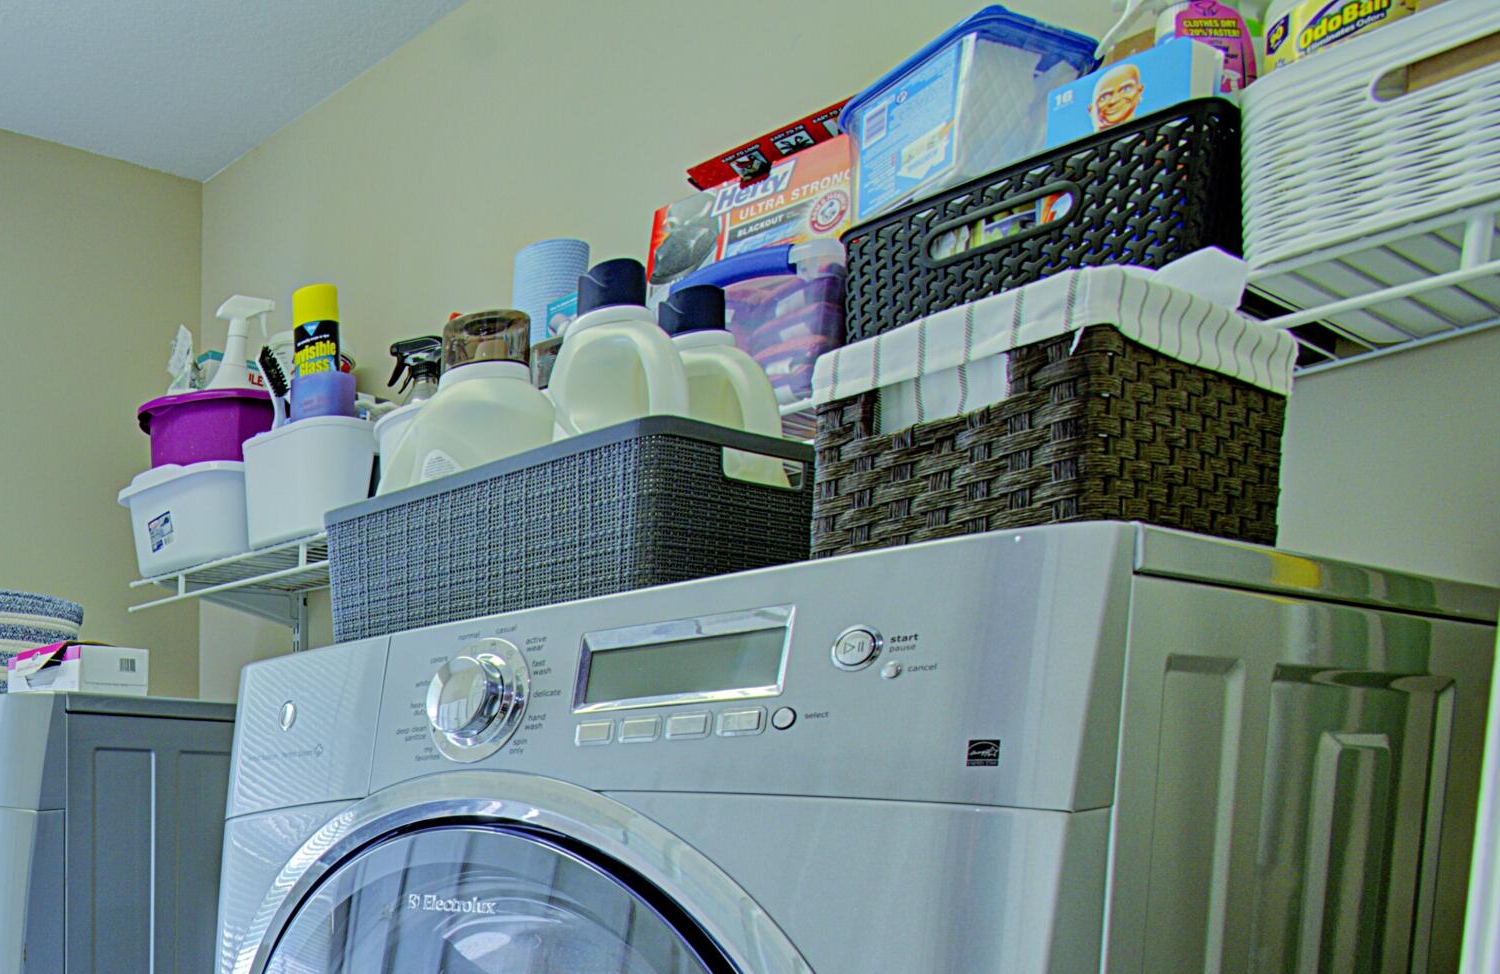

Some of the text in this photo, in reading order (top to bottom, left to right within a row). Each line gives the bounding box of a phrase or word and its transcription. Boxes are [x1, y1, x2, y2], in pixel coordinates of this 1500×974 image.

[739, 194, 786, 220] ULTRA
[737, 214, 785, 238] BLACKOUT
[525, 635, 548, 645] active
[890, 633, 919, 643] start
[889, 643, 917, 653] pause
[533, 667, 552, 676] wash
[907, 662, 938, 673] cancel
[533, 688, 562, 698] delicate
[804, 711, 829, 719] select
[422, 894, 497, 914] Electrolux
